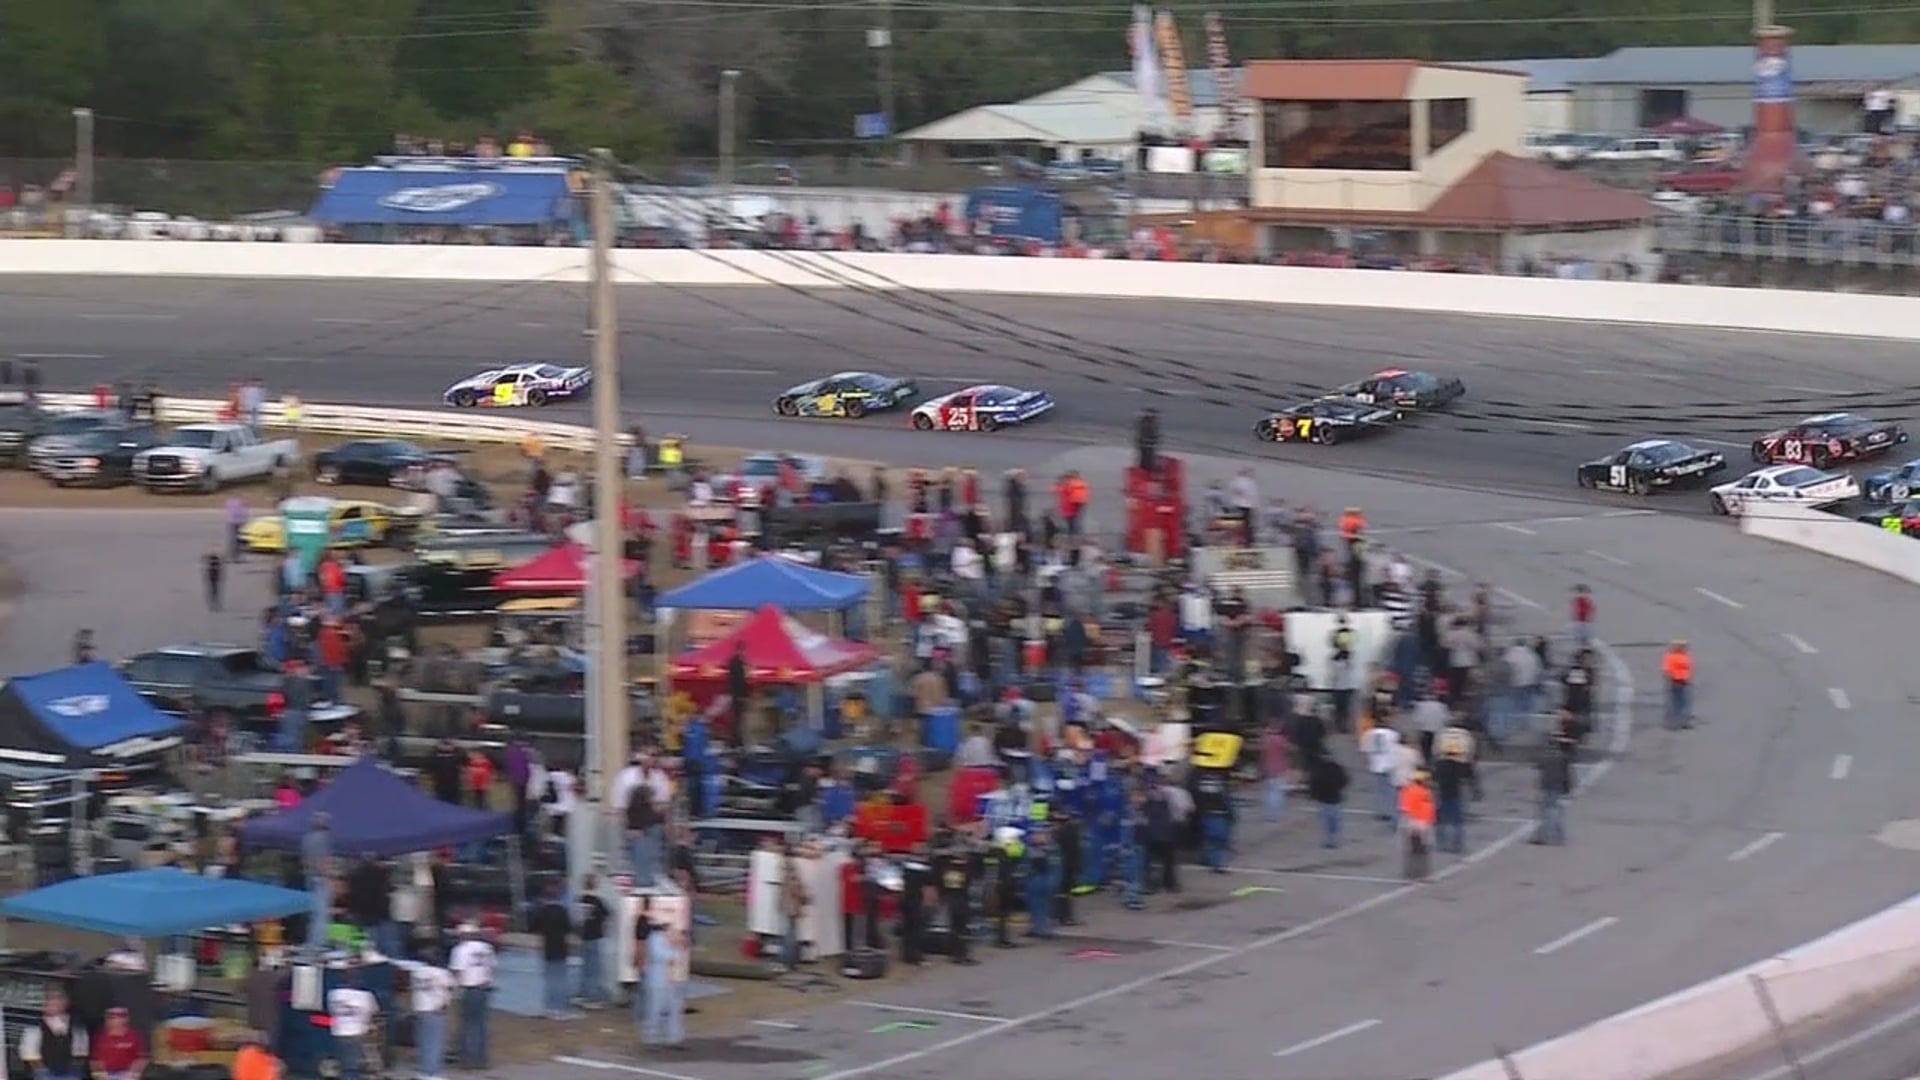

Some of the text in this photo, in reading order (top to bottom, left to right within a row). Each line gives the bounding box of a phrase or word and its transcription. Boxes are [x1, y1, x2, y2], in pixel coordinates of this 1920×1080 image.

[948, 407, 969, 426] 25
[1296, 419, 1313, 439] 7
[1610, 465, 1626, 486] 51
